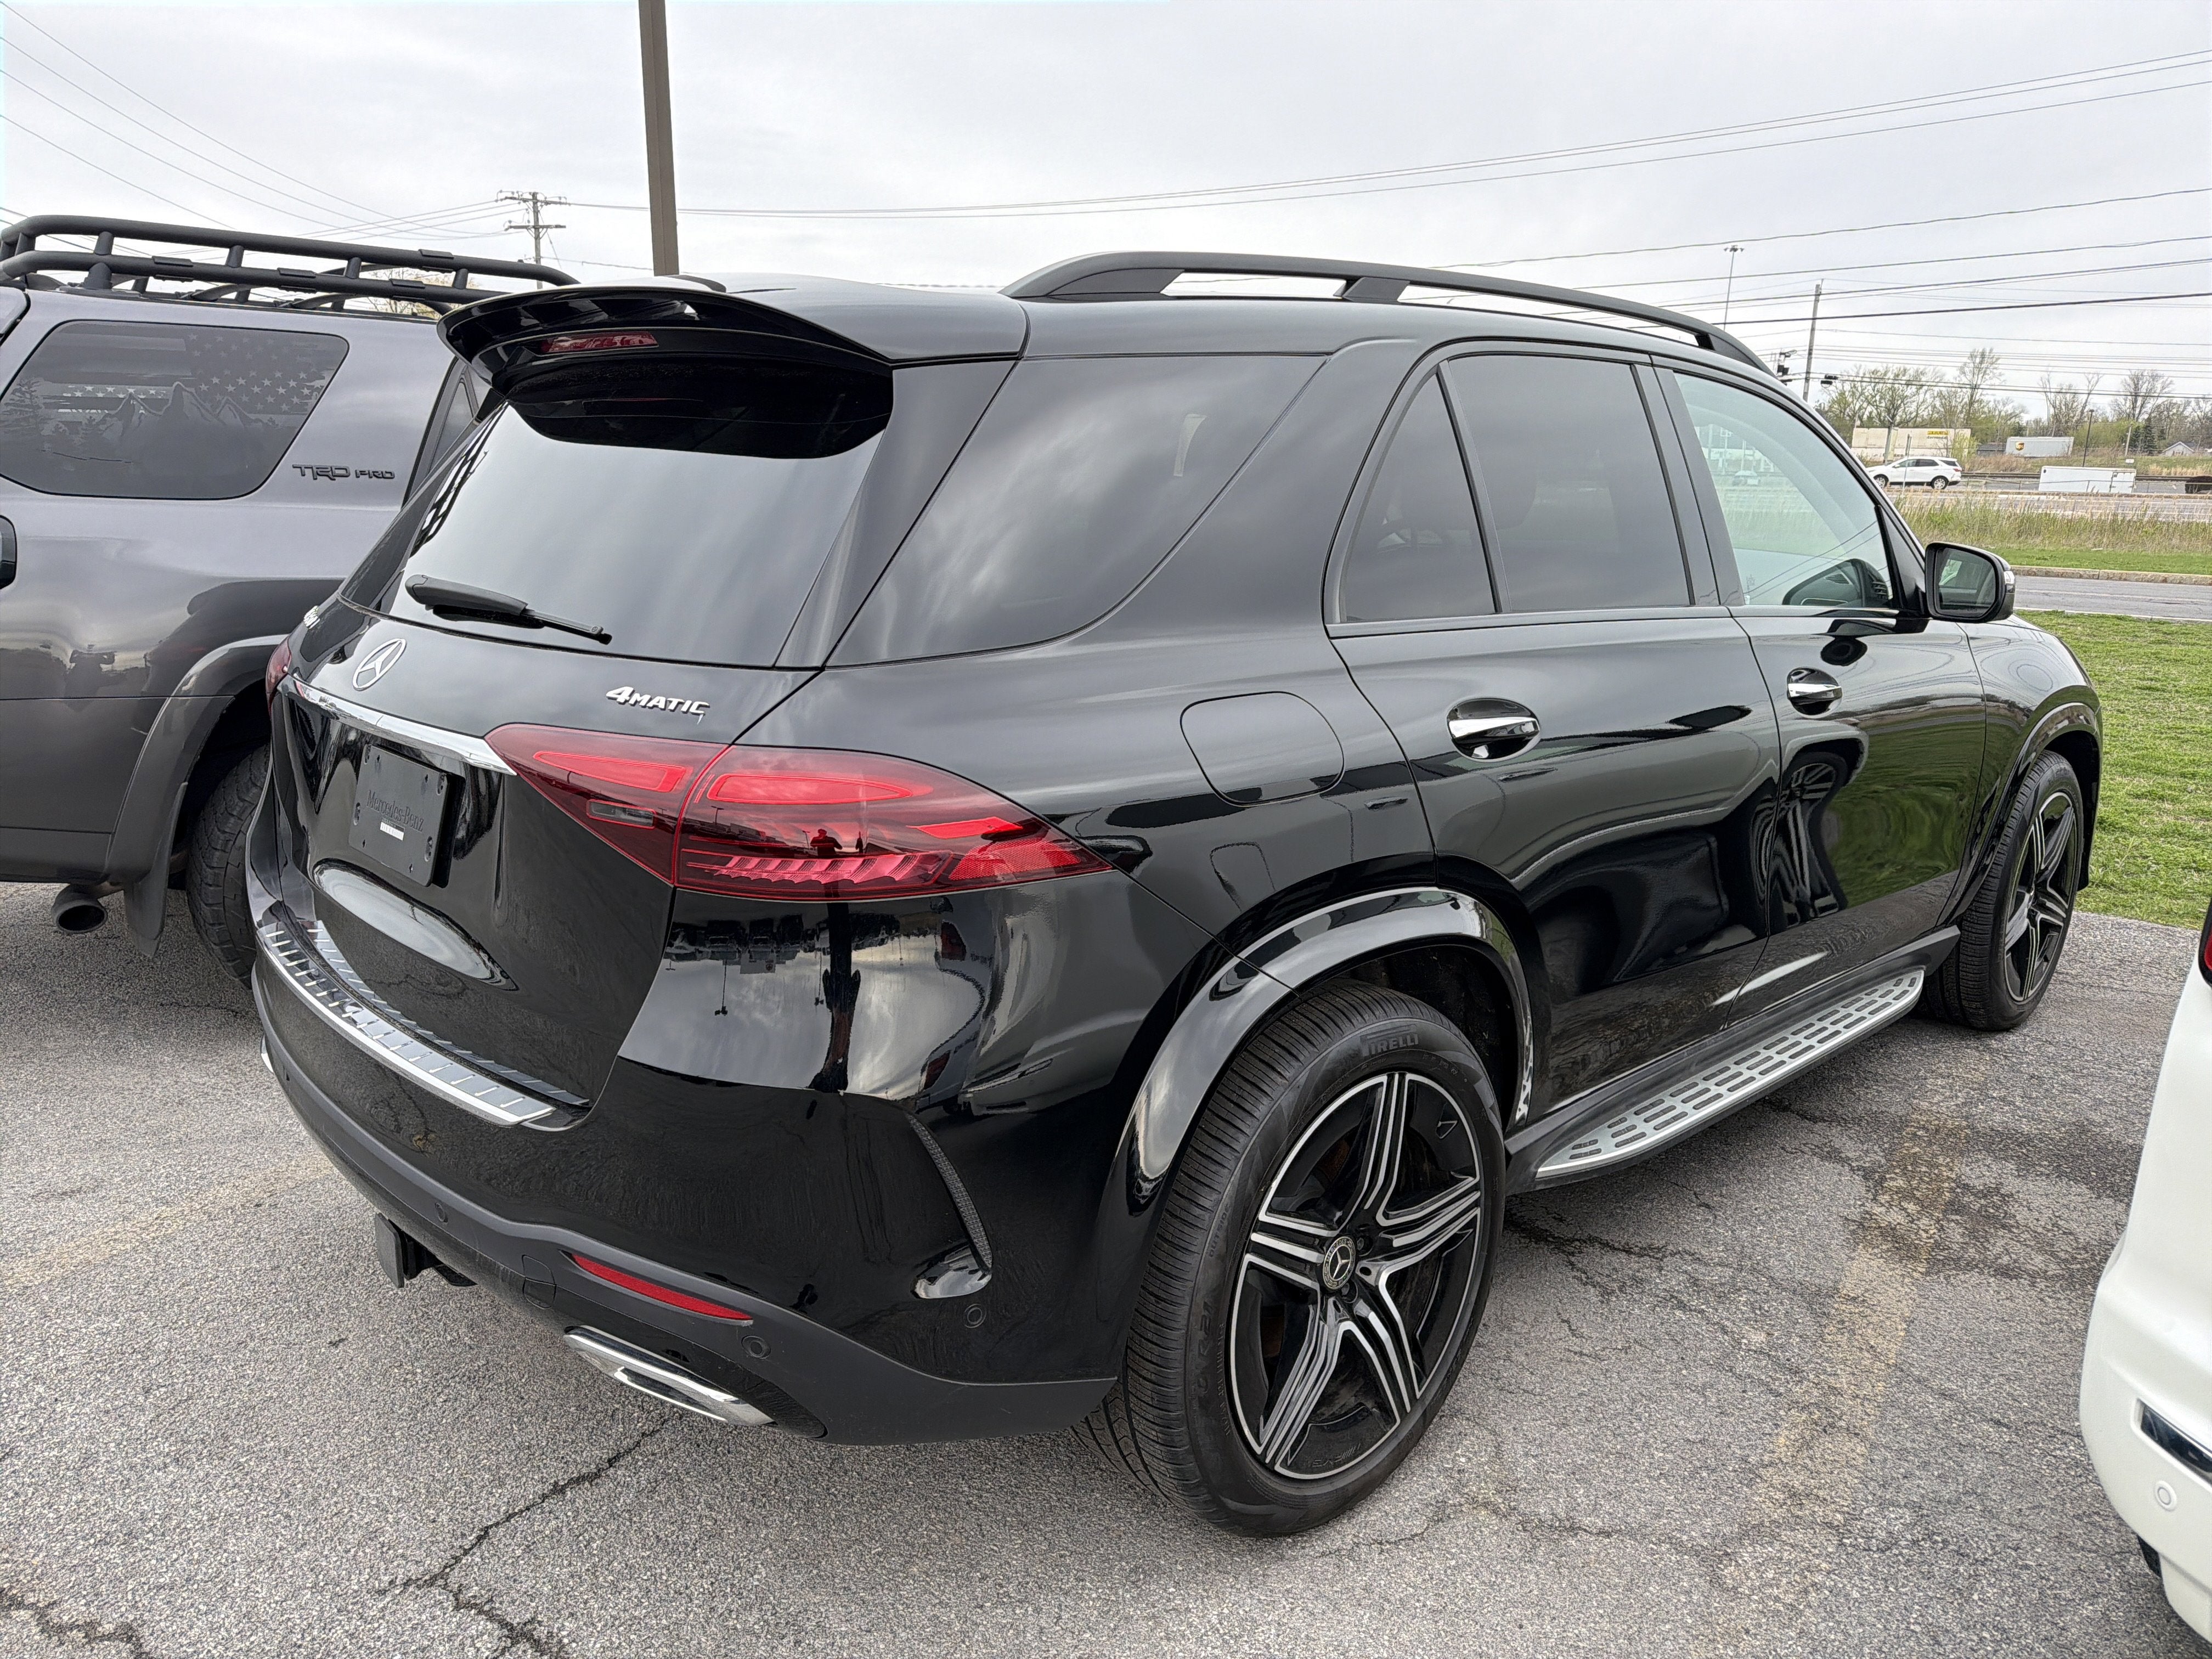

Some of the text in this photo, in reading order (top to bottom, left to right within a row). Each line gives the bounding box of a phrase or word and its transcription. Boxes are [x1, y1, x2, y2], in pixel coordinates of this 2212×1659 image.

[292, 464, 395, 481] TRD PRO
[606, 686, 710, 721] 4MATIC
[366, 790, 424, 832] Mercedes-Benz
[1360, 1024, 1419, 1057] PIRELLI
